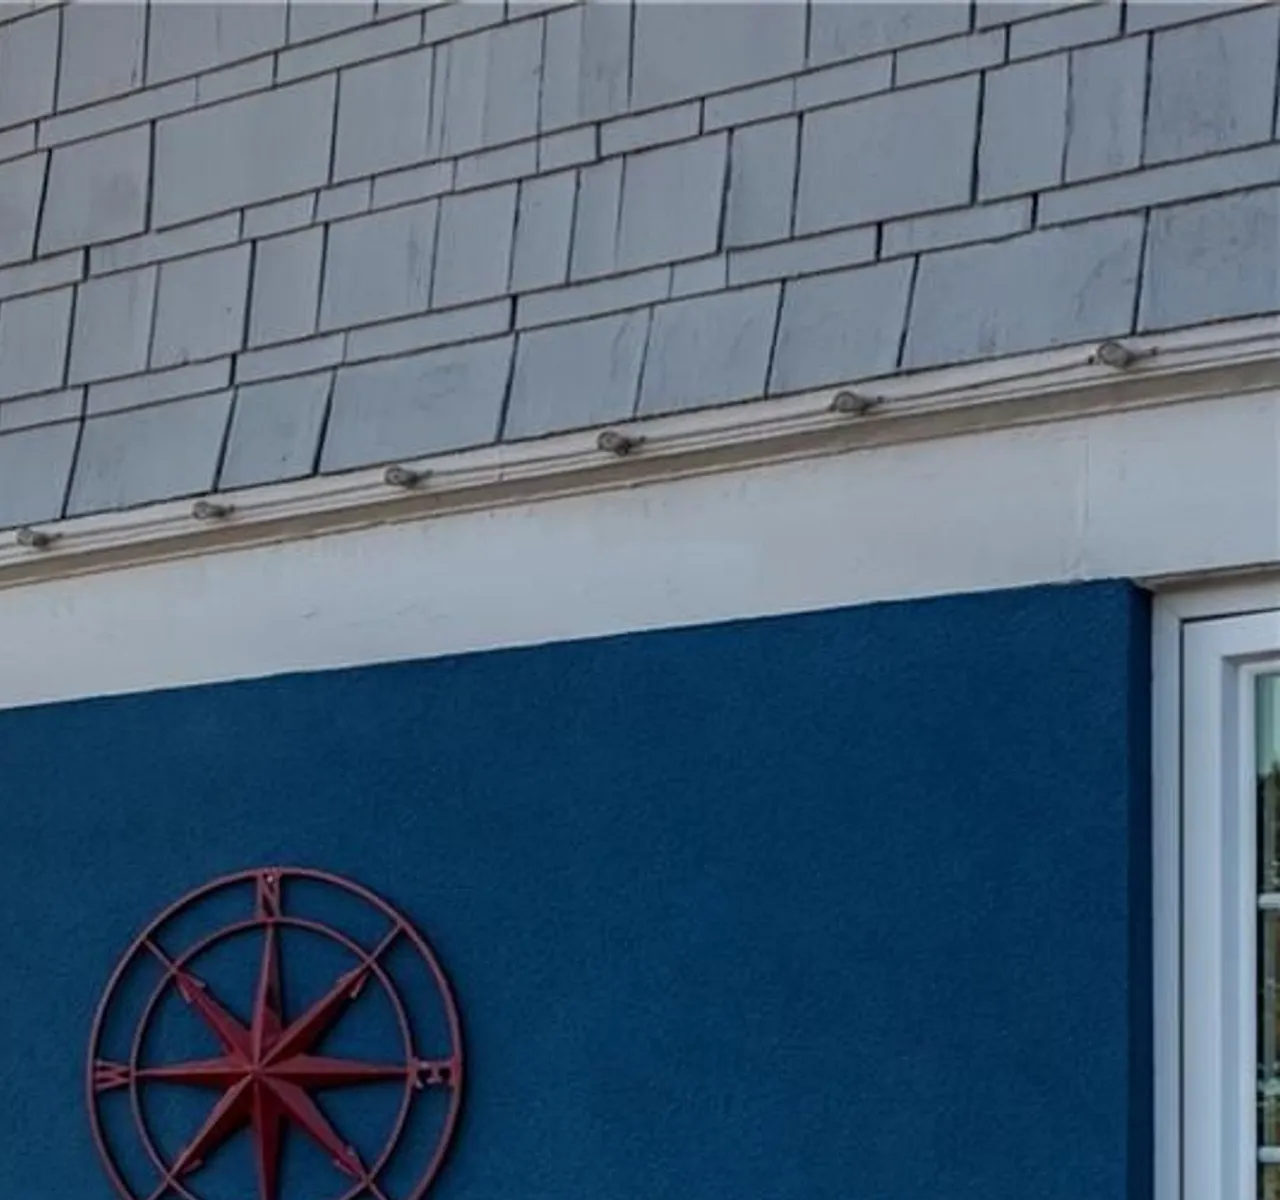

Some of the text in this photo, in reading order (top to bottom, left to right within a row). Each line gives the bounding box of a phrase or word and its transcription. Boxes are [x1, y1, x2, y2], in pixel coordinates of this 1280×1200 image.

[256, 870, 281, 919] N
[93, 1059, 133, 1090] W
[409, 1057, 458, 1089] E
